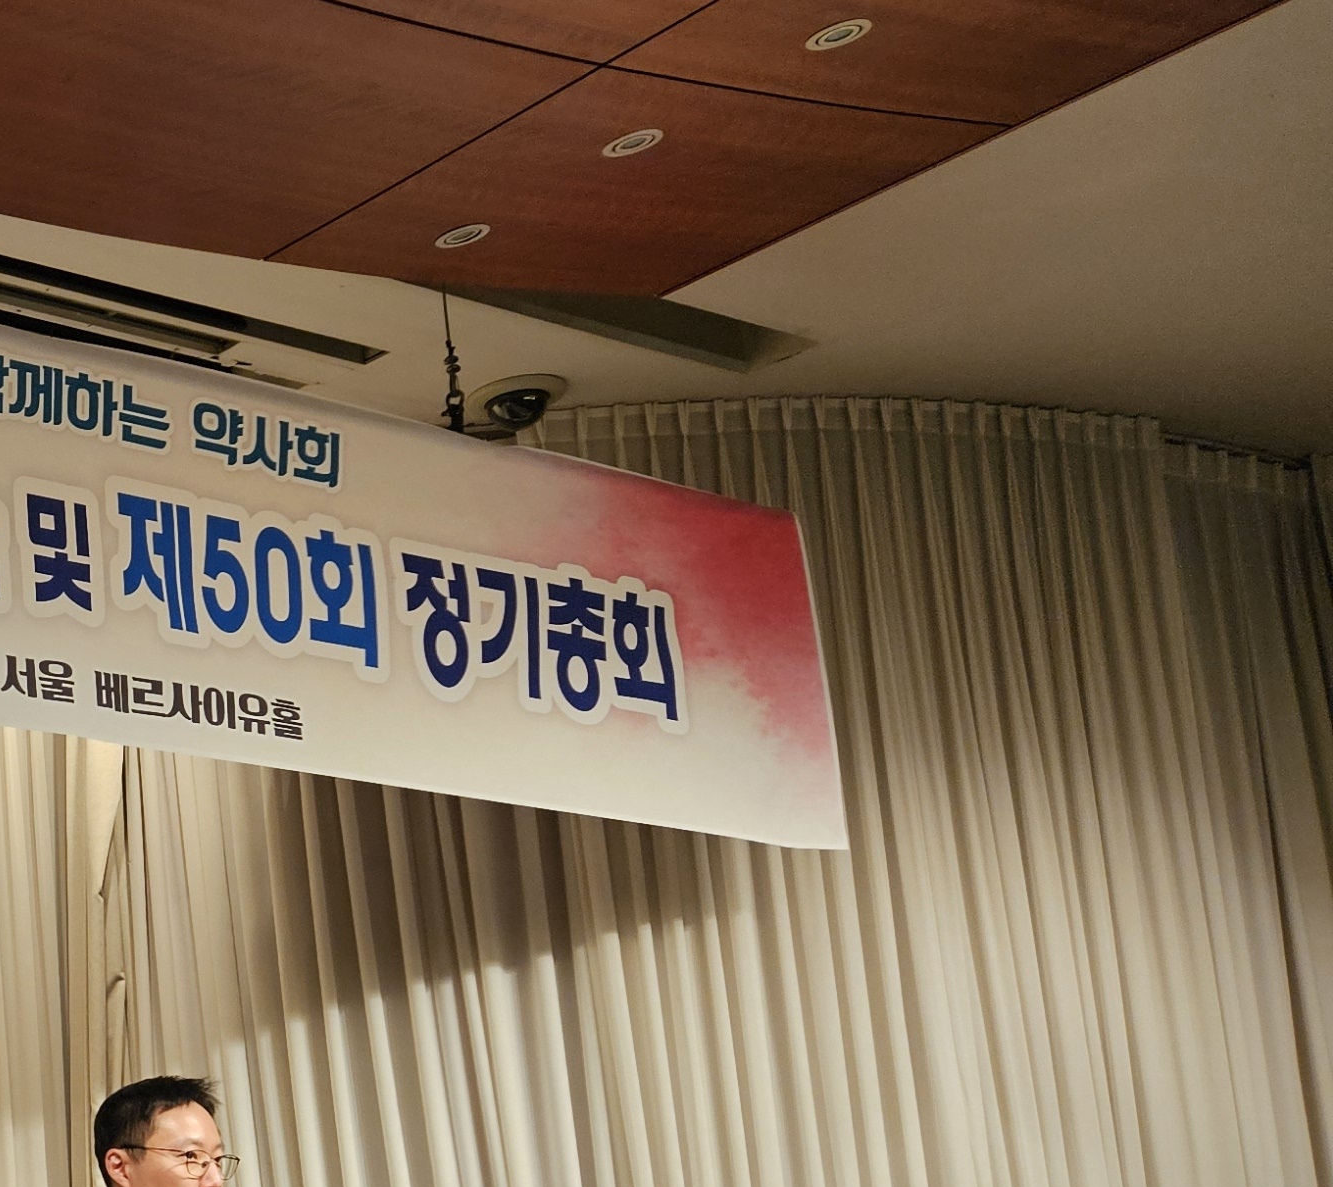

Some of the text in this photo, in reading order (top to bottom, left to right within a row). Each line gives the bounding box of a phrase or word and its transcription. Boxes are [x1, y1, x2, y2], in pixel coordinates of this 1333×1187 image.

[194, 403, 340, 488] 약사회
[27, 498, 93, 611] 및
[117, 493, 378, 668] 제50회
[401, 552, 678, 721] 정기총회
[1, 655, 74, 703] 서울
[95, 671, 303, 740] 베르사이유홀
